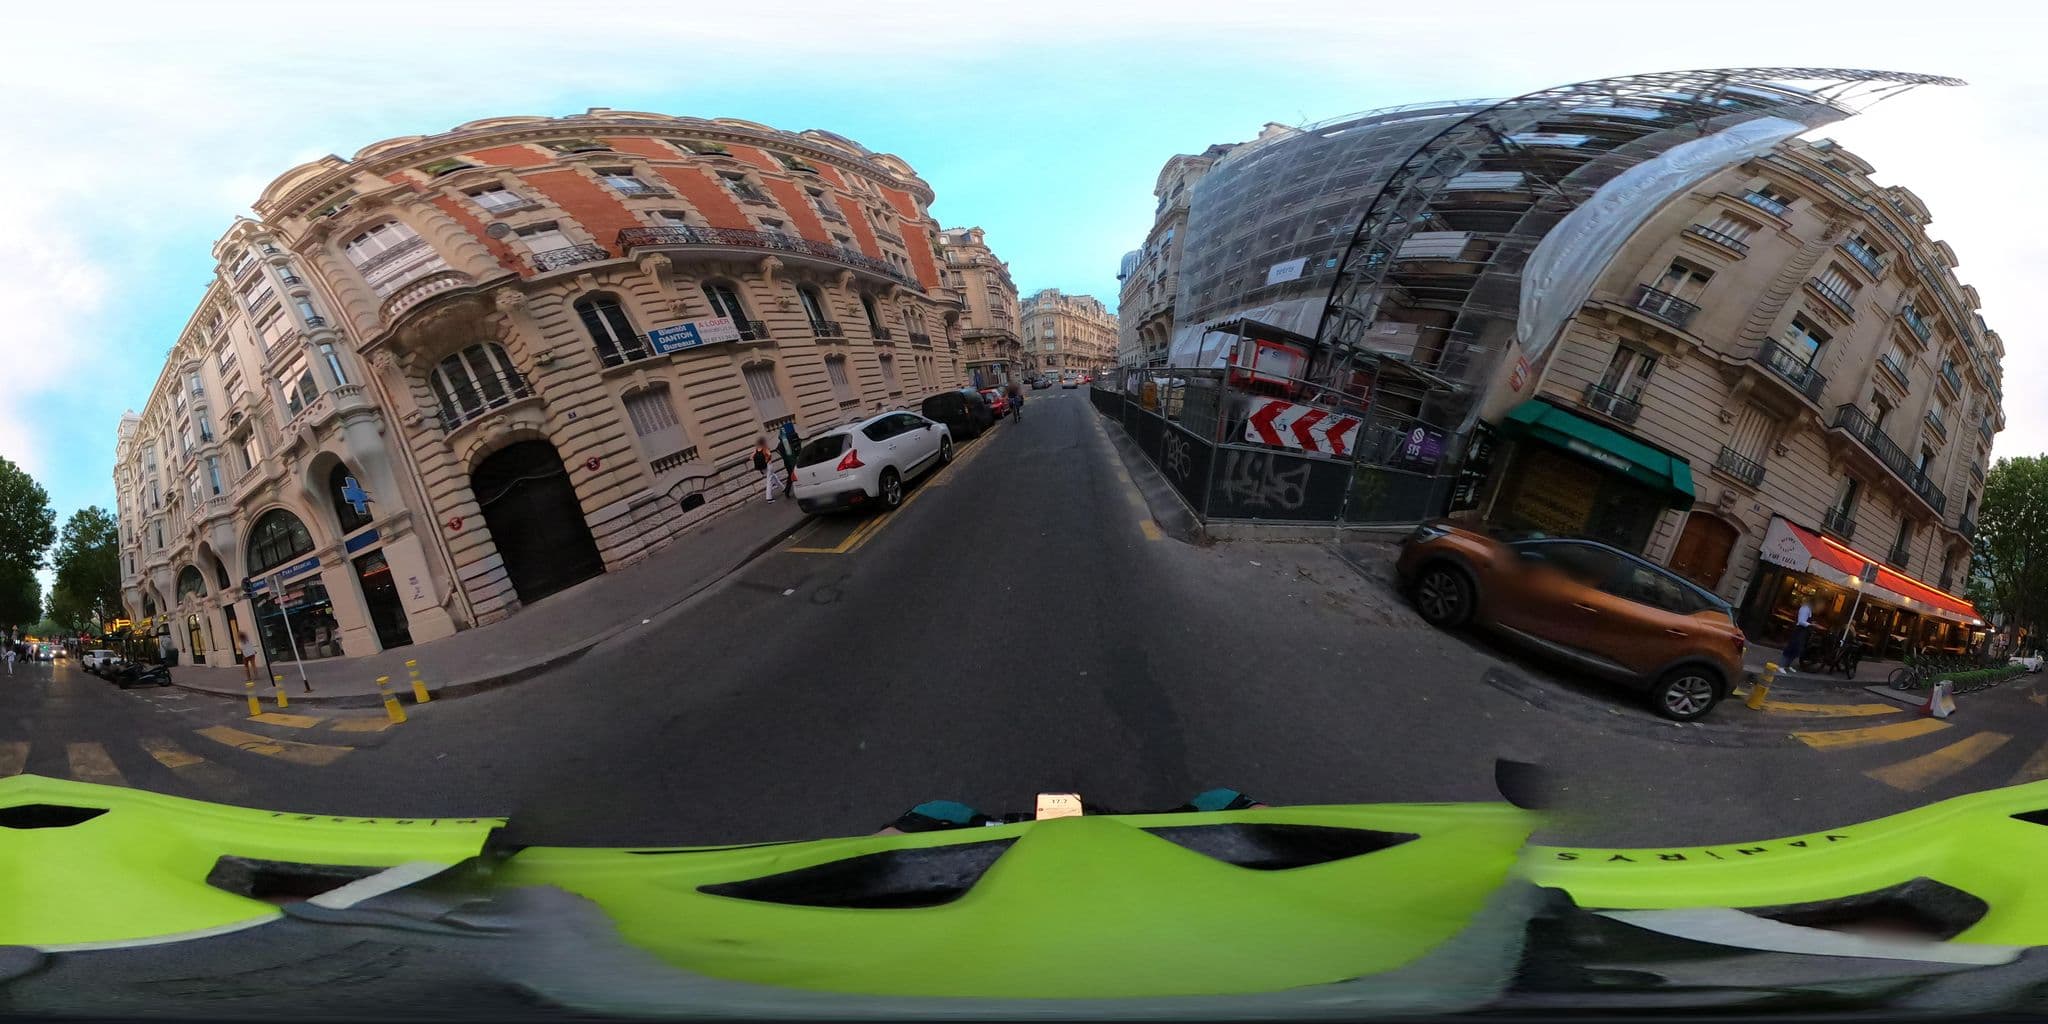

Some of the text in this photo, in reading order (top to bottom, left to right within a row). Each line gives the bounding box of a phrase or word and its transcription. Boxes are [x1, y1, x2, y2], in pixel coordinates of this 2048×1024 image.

[706, 318, 729, 328] LOUER
[658, 325, 687, 336] Bientôt
[658, 331, 693, 344] DANTON
[663, 340, 696, 351] Bureaux
